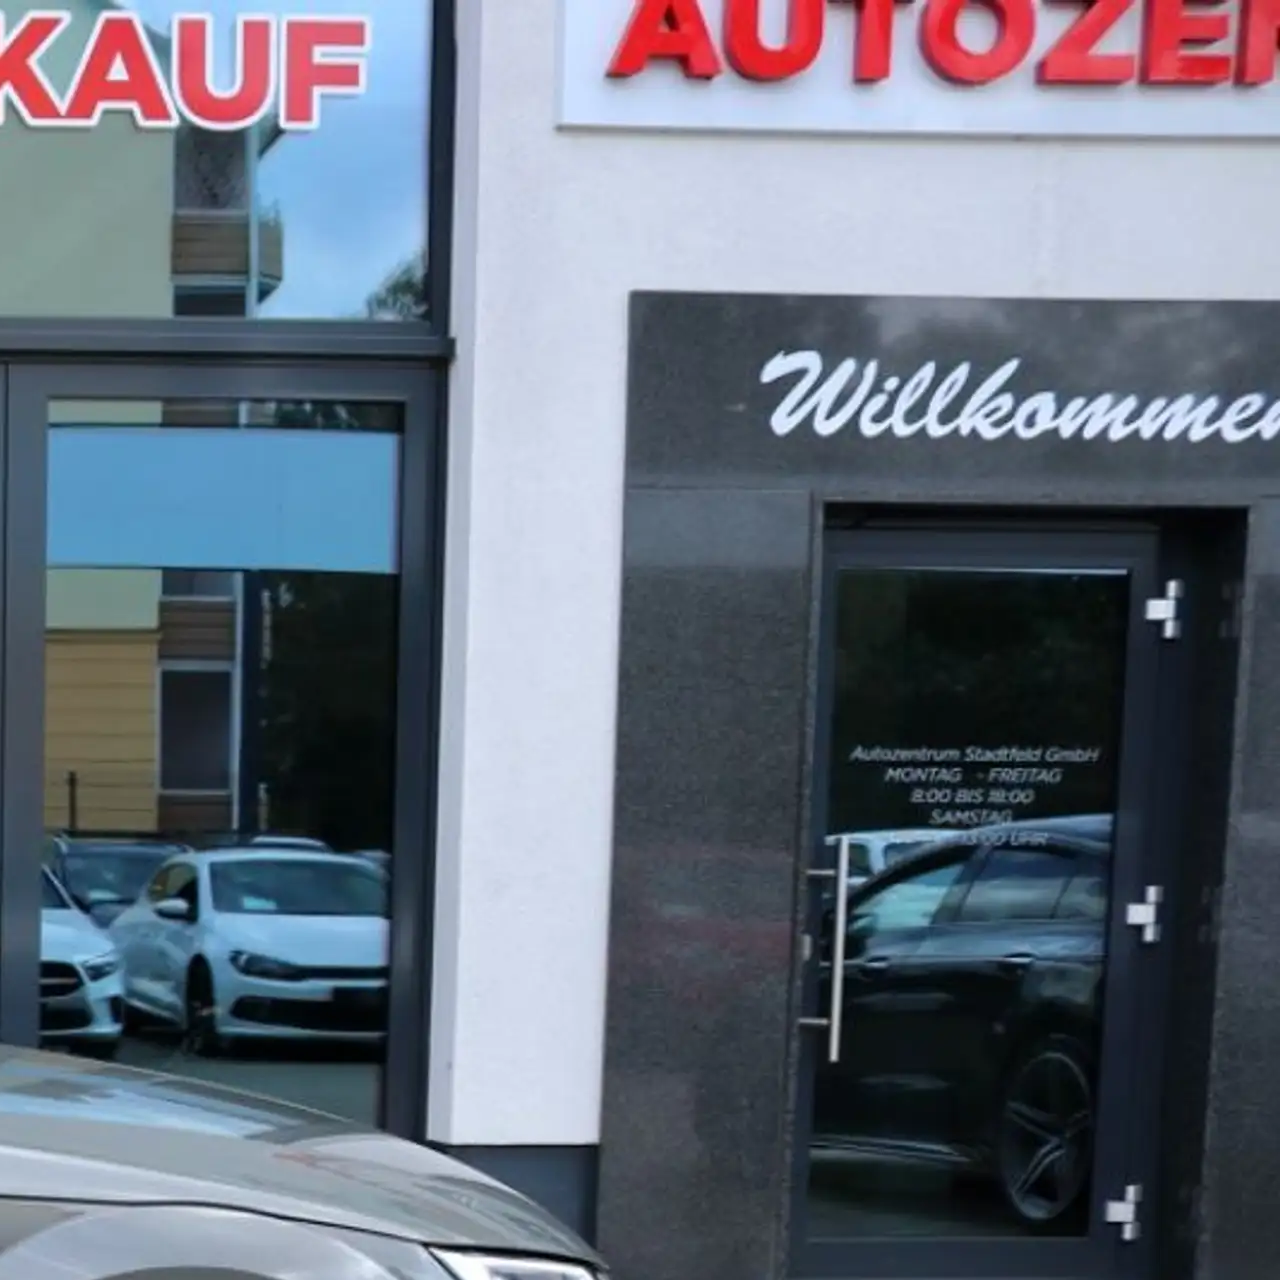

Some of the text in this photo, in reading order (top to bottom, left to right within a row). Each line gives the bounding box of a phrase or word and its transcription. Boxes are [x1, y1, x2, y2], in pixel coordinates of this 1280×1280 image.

[849, 745, 1101, 763] Autozentrum Stadtfeld GmbH
[884, 767, 963, 783] MONTAG
[988, 767, 1064, 783] FREITAG
[954, 788, 984, 803] BIS
[928, 808, 1013, 825] SAMSTAG
